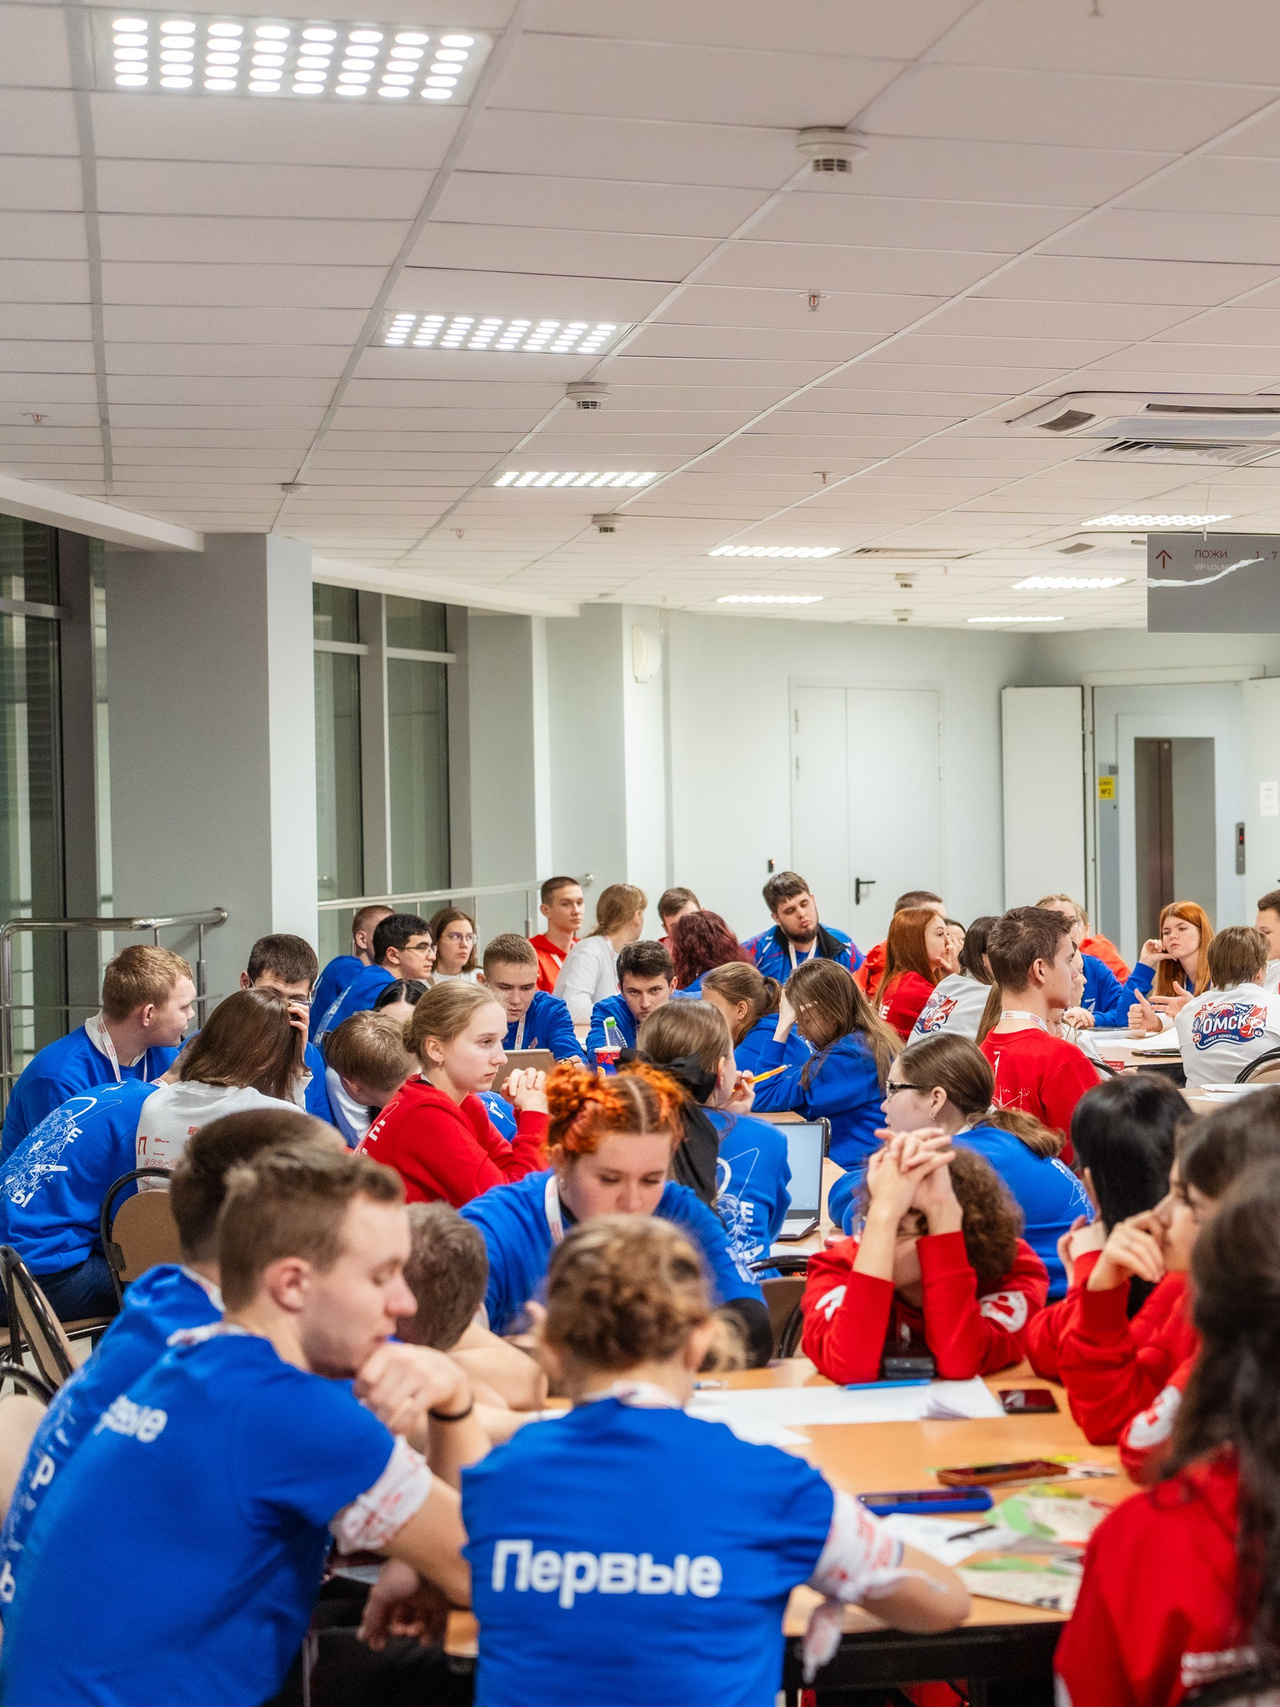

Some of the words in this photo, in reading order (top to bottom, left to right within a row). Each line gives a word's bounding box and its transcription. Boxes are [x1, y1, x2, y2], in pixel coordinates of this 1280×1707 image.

[1194, 549, 1228, 559] ЛОЖИ
[1255, 551, 1260, 559] 1
[1271, 551, 1278, 560] 7
[1193, 563, 1206, 571] VIP
[1206, 563, 1234, 571] LOUN
[1202, 1014, 1248, 1034] ОМСК
[491, 1538, 724, 1610] Первые
